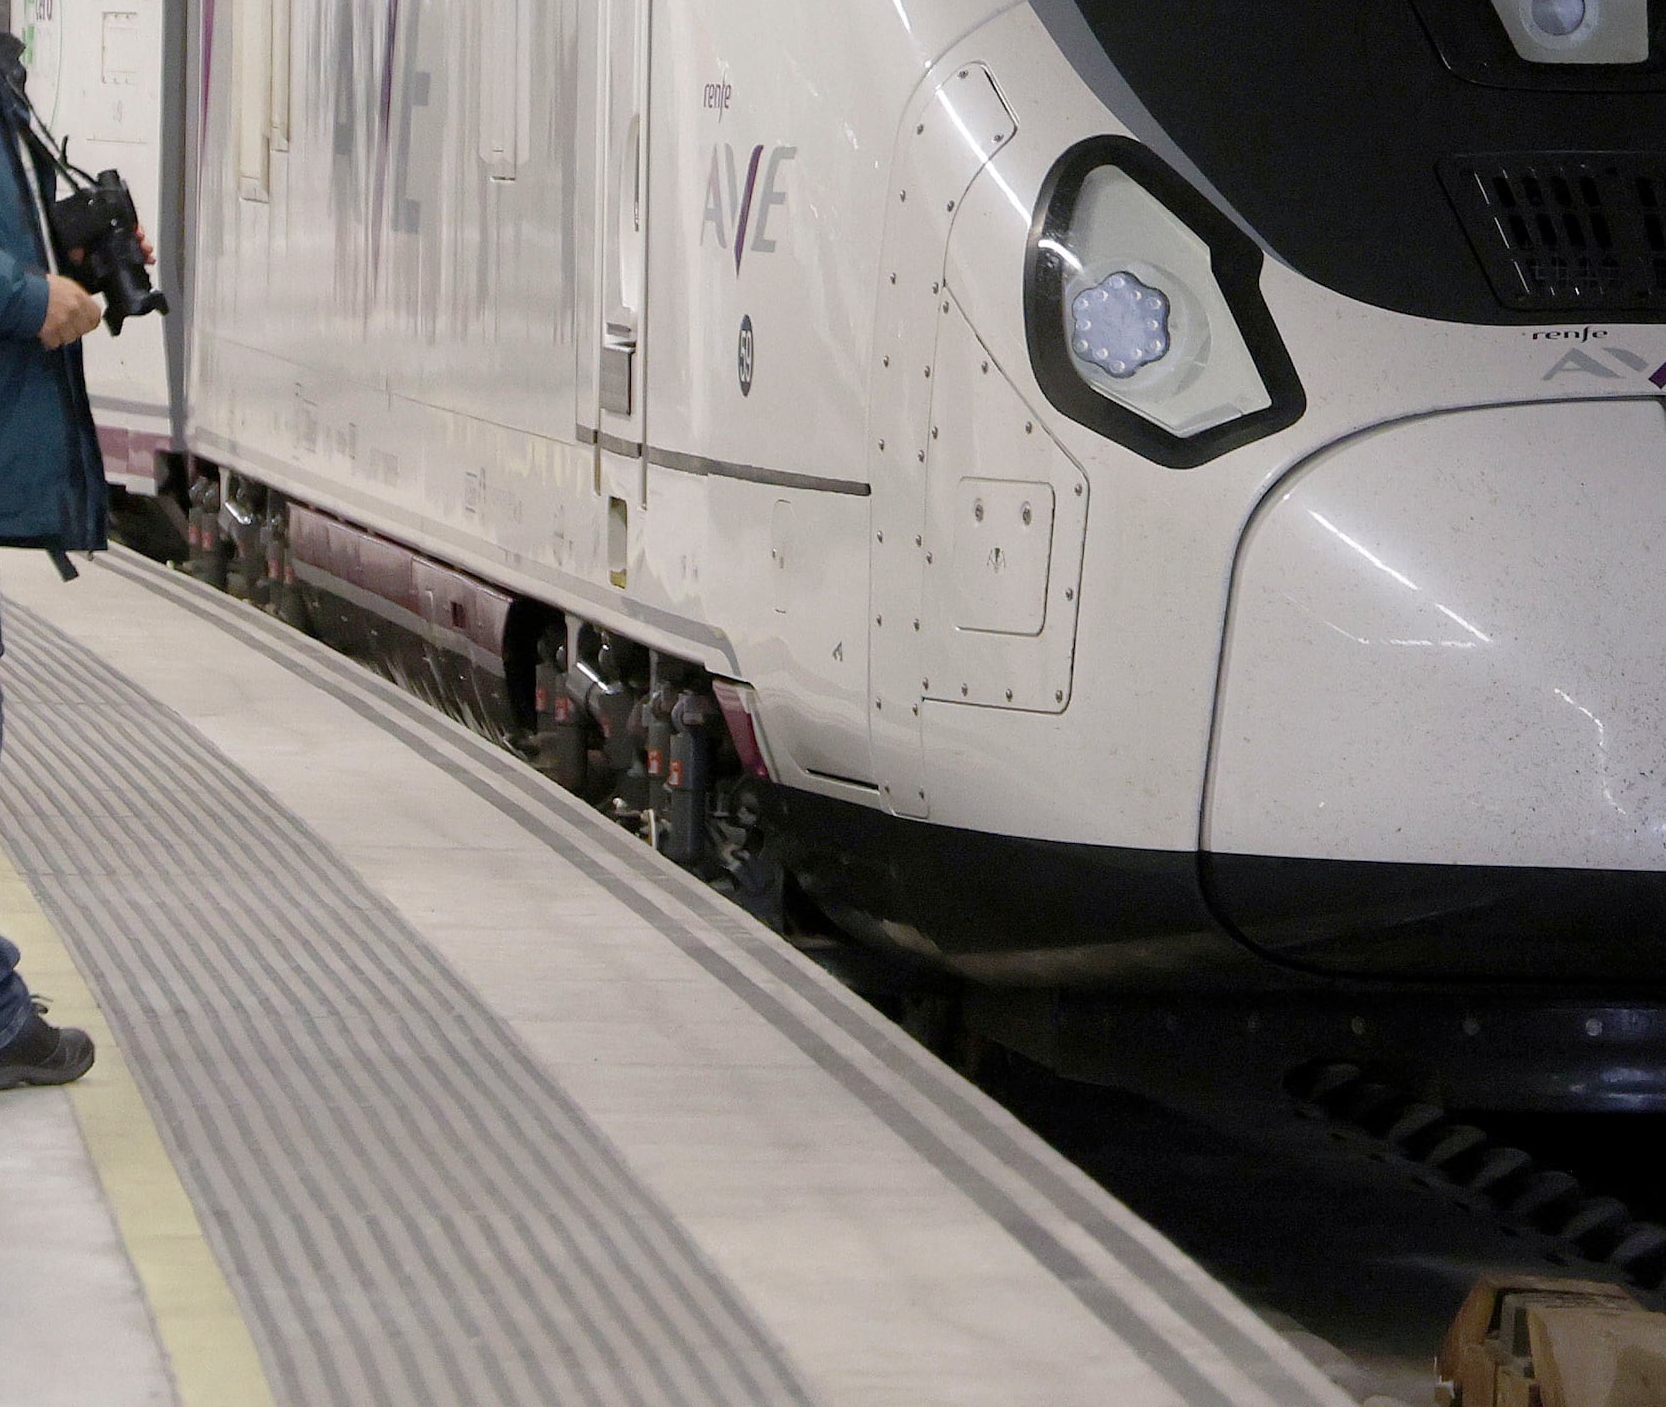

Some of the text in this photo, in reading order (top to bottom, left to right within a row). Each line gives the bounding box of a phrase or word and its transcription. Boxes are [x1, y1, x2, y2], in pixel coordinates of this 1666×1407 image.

[703, 71, 732, 123] renfe
[699, 143, 797, 279] AVE
[1533, 326, 1608, 343] renfe
